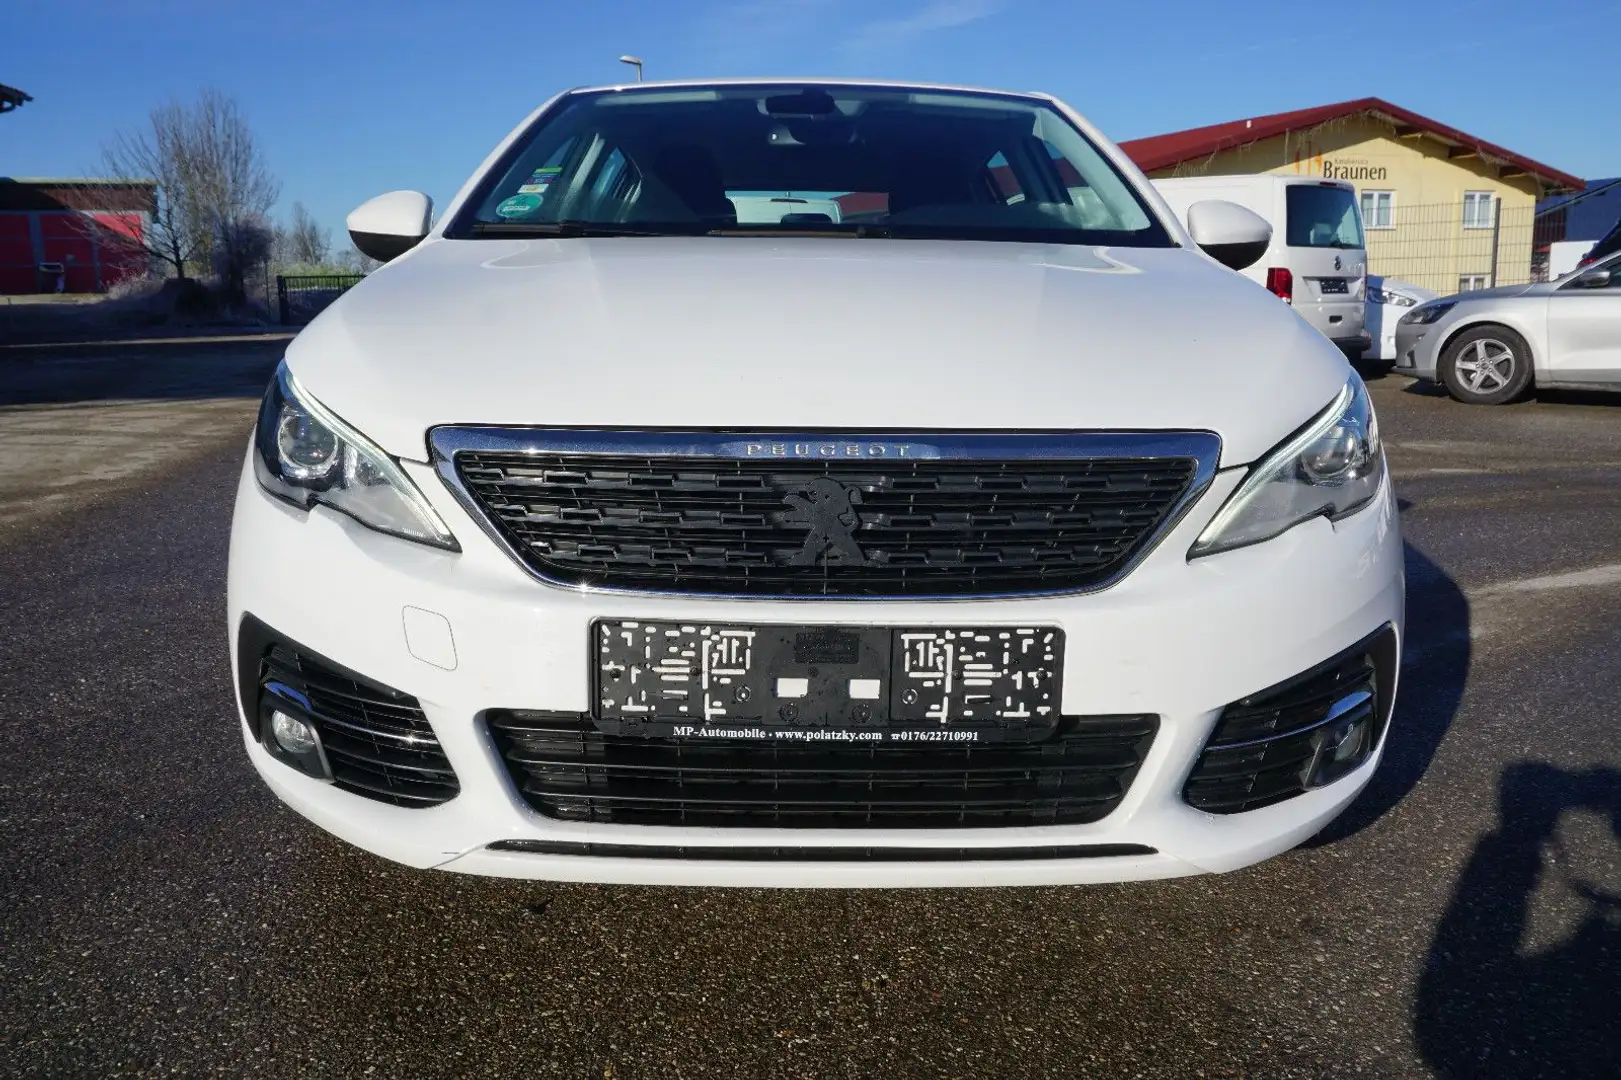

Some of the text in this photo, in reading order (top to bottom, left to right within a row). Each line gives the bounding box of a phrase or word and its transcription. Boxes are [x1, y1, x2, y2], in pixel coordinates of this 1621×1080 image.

[1323, 160, 1387, 180] Braunen
[747, 443, 909, 457] PEUGEOT
[673, 726, 978, 741] MP-Automobile www.polatzky.com 0176/22710991
